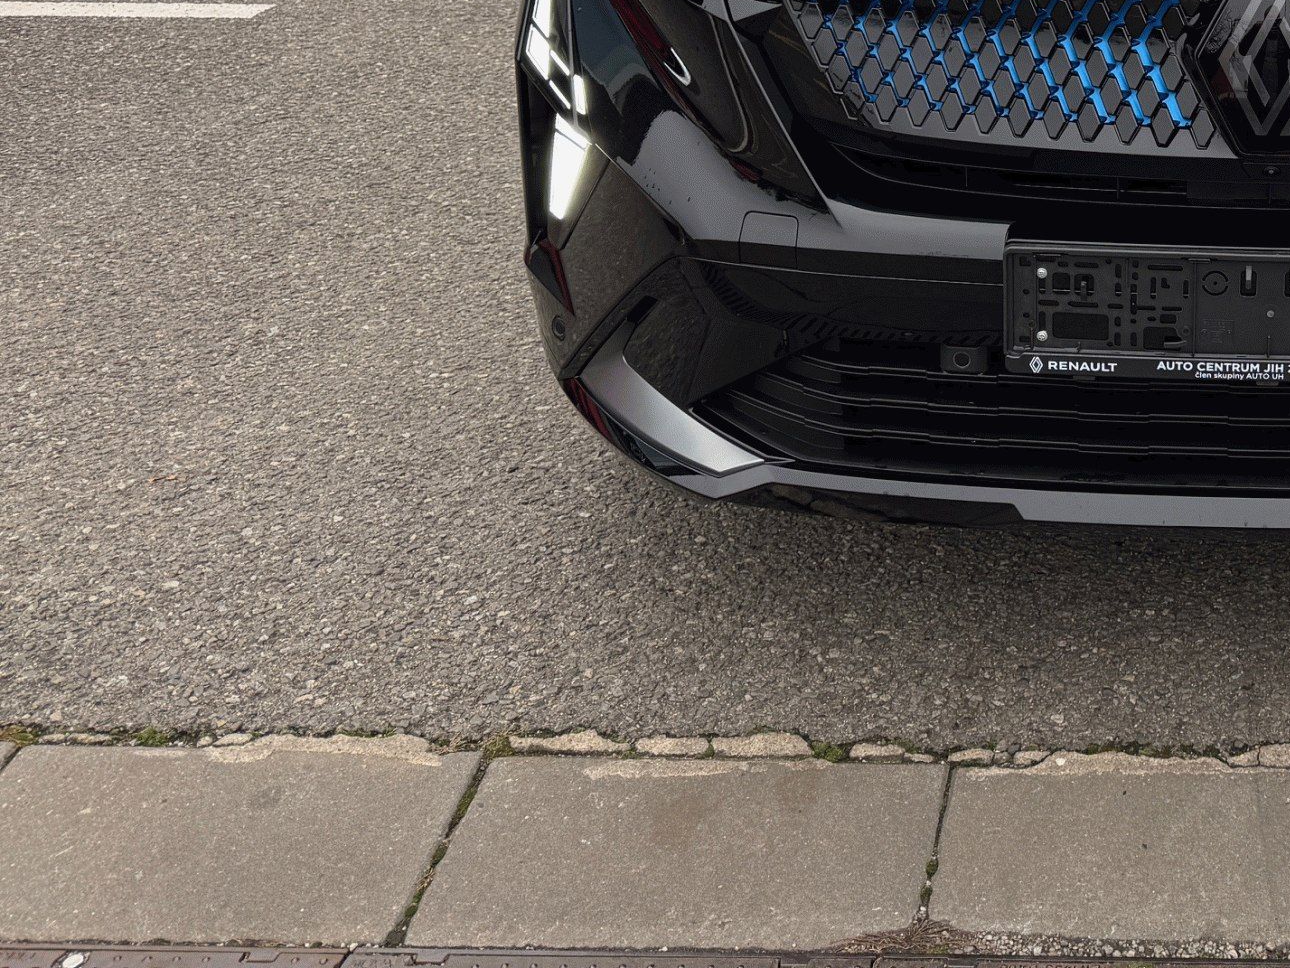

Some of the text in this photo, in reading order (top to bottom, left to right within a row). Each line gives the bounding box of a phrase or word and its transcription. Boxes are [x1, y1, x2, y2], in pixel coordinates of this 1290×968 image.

[1047, 360, 1118, 372] RENAULT
[1156, 361, 1193, 372] AUTO
[1196, 362, 1260, 373] CENTRUM
[1263, 363, 1284, 374] JIH
[1195, 371, 1212, 379] člen
[1213, 372, 1244, 380] skupiny
